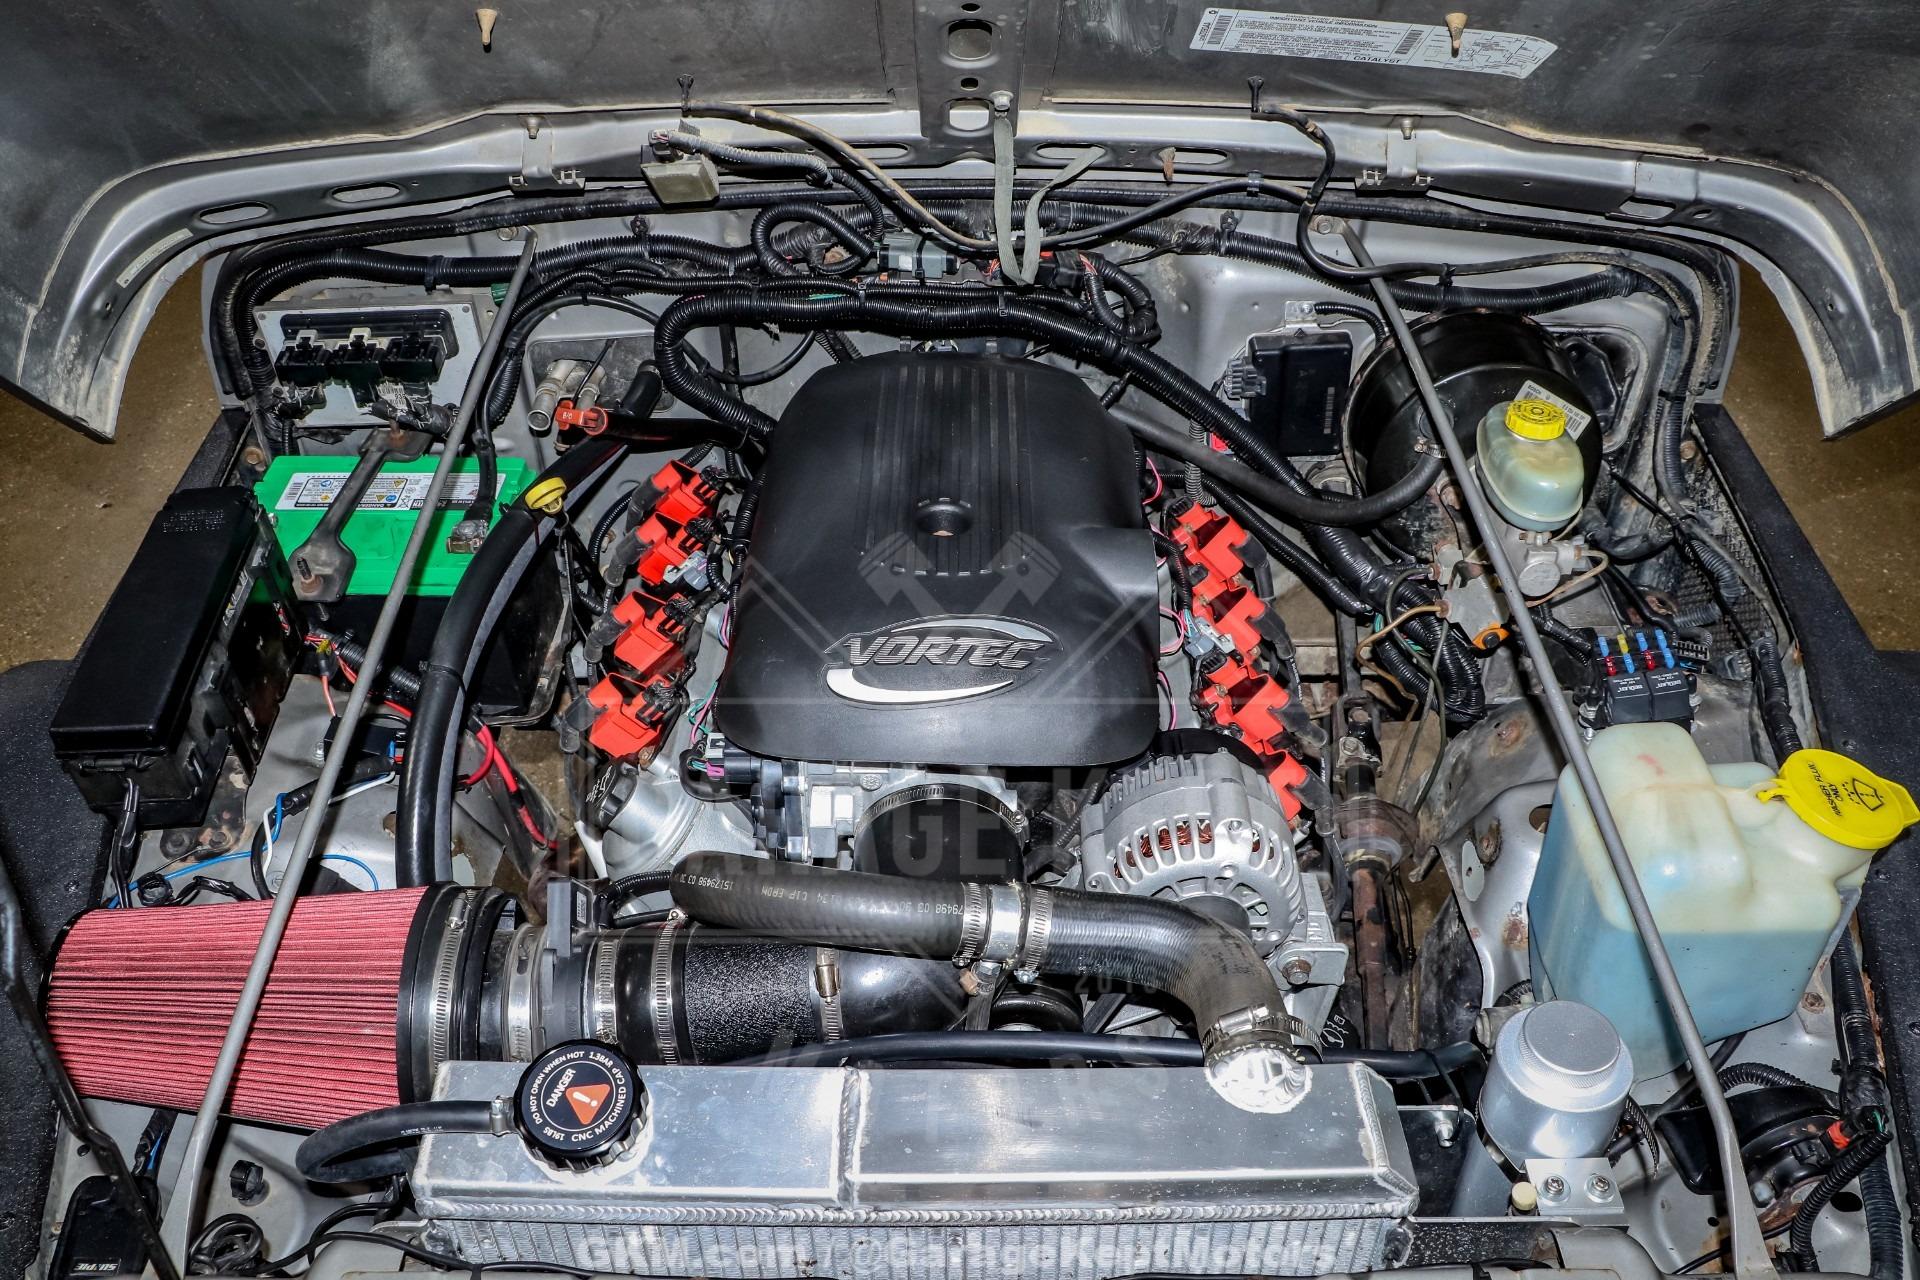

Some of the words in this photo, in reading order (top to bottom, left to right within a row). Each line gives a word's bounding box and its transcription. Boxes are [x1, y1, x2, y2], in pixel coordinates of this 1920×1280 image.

[1353, 55, 1400, 64] CATALYST
[843, 636, 1045, 669] VORTEC
[566, 1051, 585, 1060] HOT
[588, 1051, 614, 1068] 1.3BAR
[543, 1055, 567, 1075] WHEN
[530, 1073, 545, 1094] OPEN
[546, 1068, 576, 1107] DANGER
[529, 1096, 538, 1112] NOT
[571, 1130, 594, 1142] CNC
[594, 1086, 627, 1136] MACHINED
[611, 1067, 626, 1085] CAP
[532, 1113, 543, 1125] DO
